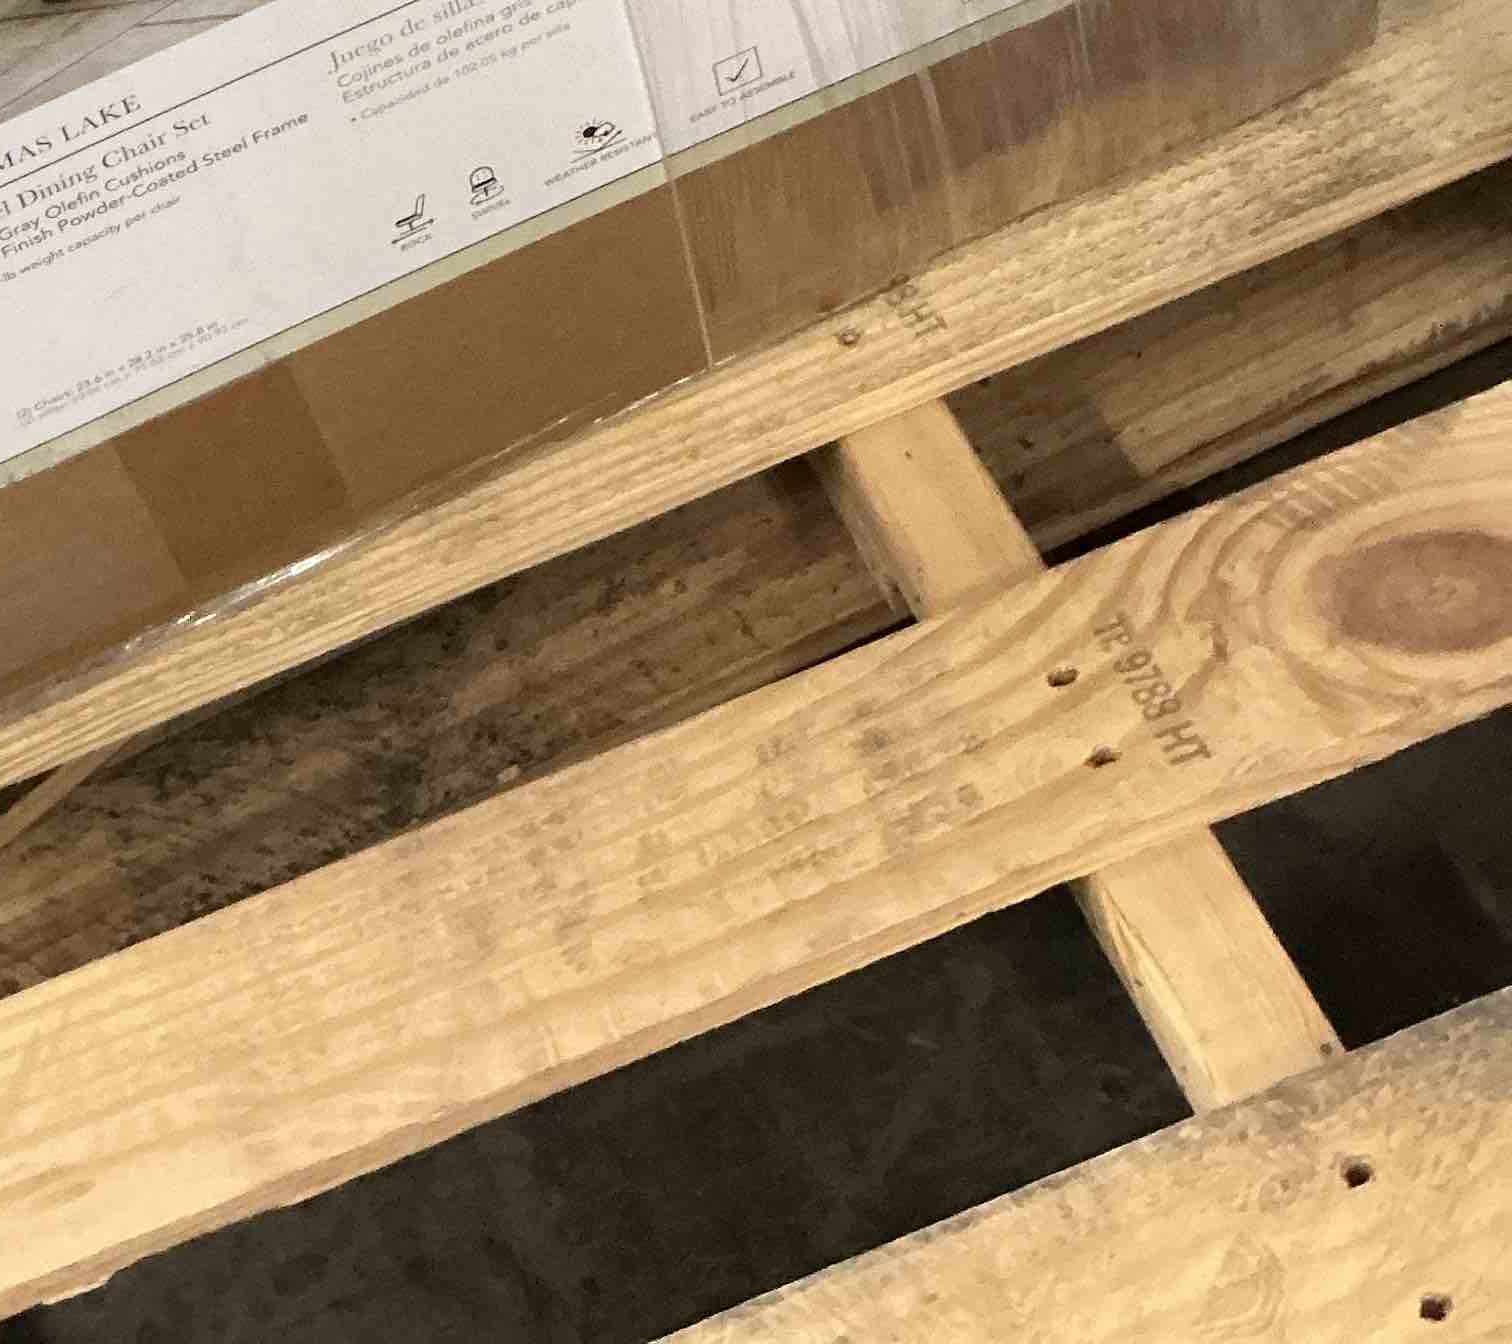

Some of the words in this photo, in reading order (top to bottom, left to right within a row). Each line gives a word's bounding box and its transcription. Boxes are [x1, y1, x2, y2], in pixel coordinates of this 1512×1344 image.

[327, 33, 393, 75] Juego
[400, 15, 425, 38] de
[336, 54, 404, 88] Cojines
[408, 42, 431, 59] de
[436, 12, 495, 46] olefina
[342, 61, 432, 104] Estructura
[437, 46, 459, 63] de
[465, 22, 514, 51] acero
[518, 7, 539, 26] de
[58, 94, 142, 143] LAKE
[1, 228, 53, 258] Finish
[57, 160, 199, 232] Powder-Coated
[202, 138, 248, 167] Steel
[251, 113, 309, 145] Frame
[16, 164, 98, 209] Dining
[101, 132, 168, 169] Chair
[44, 190, 101, 219] Olefin
[104, 151, 187, 192] Cushions
[20, 249, 64, 274] weight
[67, 224, 121, 253] capacity
[125, 211, 147, 230] per
[151, 195, 181, 214] chair
[1154, 720, 1212, 765] HT
